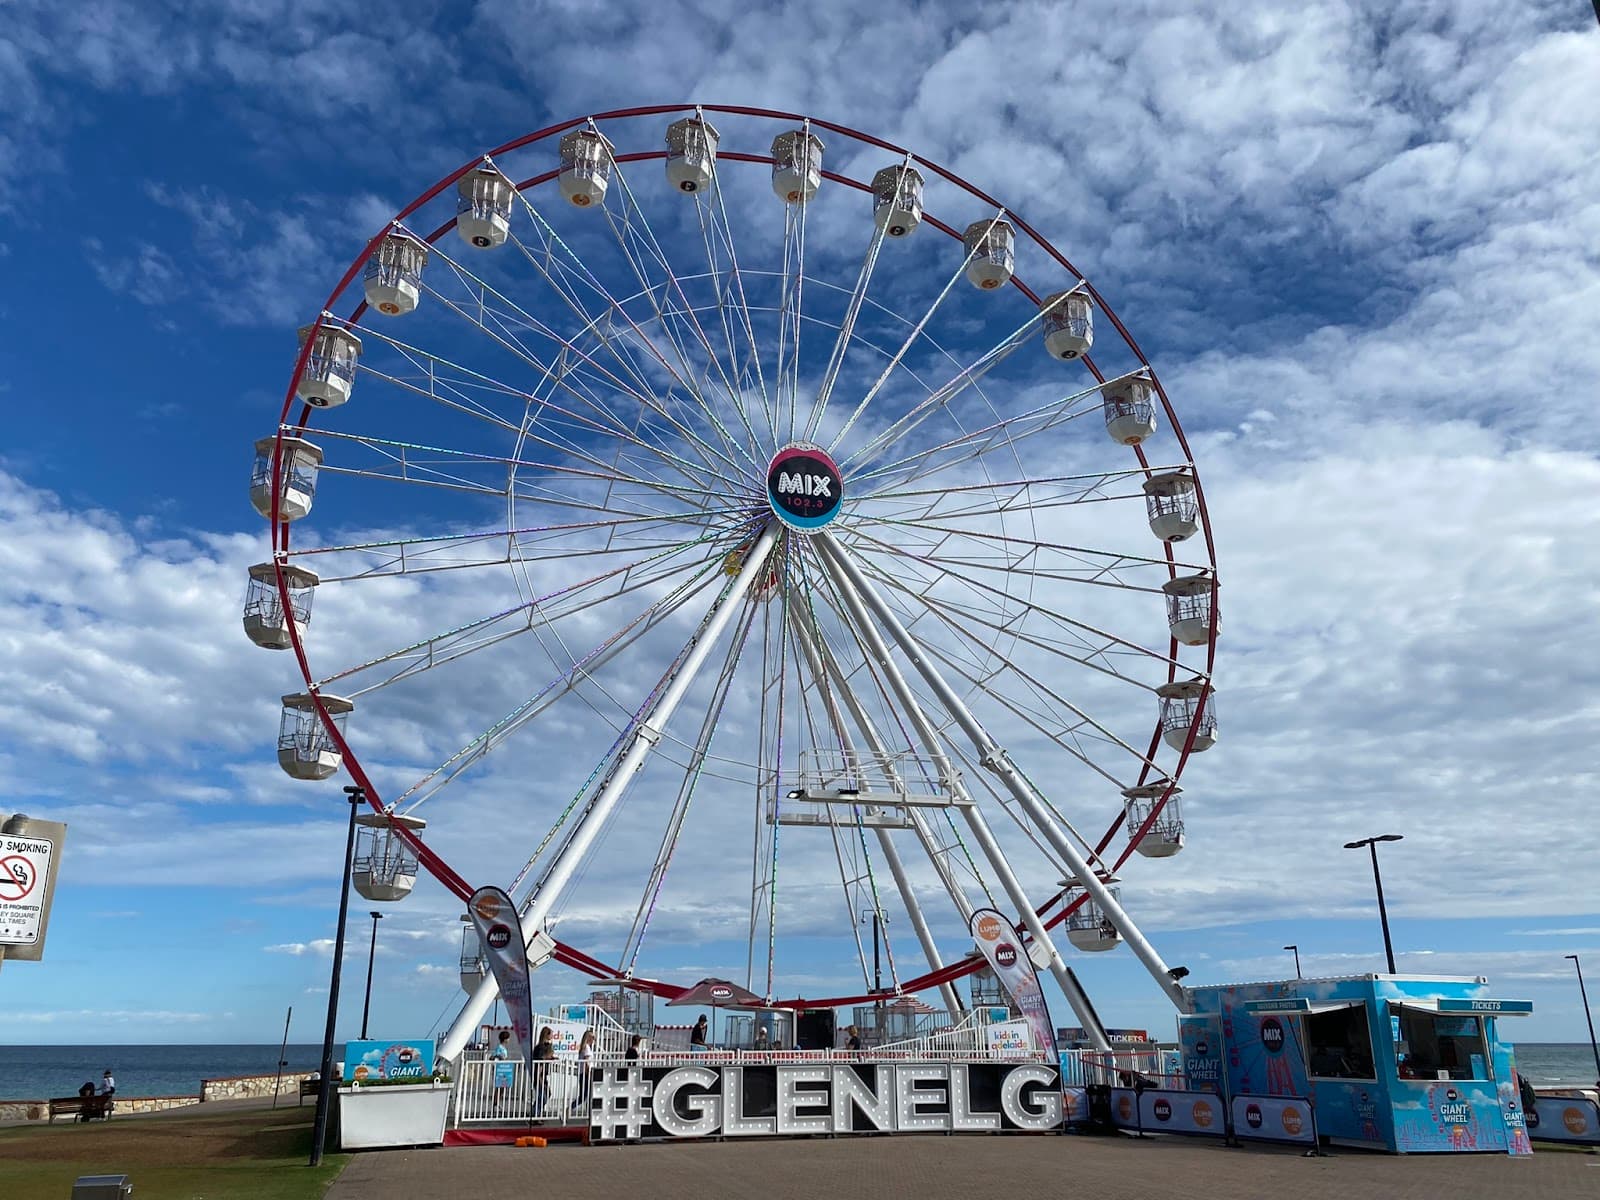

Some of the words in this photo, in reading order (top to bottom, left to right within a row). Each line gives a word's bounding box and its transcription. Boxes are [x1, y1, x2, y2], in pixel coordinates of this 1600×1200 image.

[778, 471, 832, 497] MIX
[7, 841, 48, 854] SMOKING
[489, 932, 508, 942] MIX
[998, 951, 1014, 960] MIX
[1472, 1001, 1501, 1010] TICKETS
[565, 1031, 574, 1040] in
[994, 1031, 1010, 1040] kids
[1011, 1031, 1019, 1039] in
[1109, 1034, 1144, 1043] TICKETS
[1263, 1029, 1281, 1041] MIX
[991, 1040, 1028, 1050] adelaide
[1187, 1059, 1220, 1070] GIANT
[390, 1066, 422, 1076] GIANT
[1191, 1070, 1219, 1080] WHEEL
[591, 1064, 1062, 1139] #GLENELG
[1155, 1106, 1170, 1115] MIX
[1440, 1104, 1468, 1114] GIANT
[1248, 1112, 1261, 1121] MIX
[1443, 1114, 1468, 1123] WHEEL
[1504, 1112, 1523, 1120] GIANT
